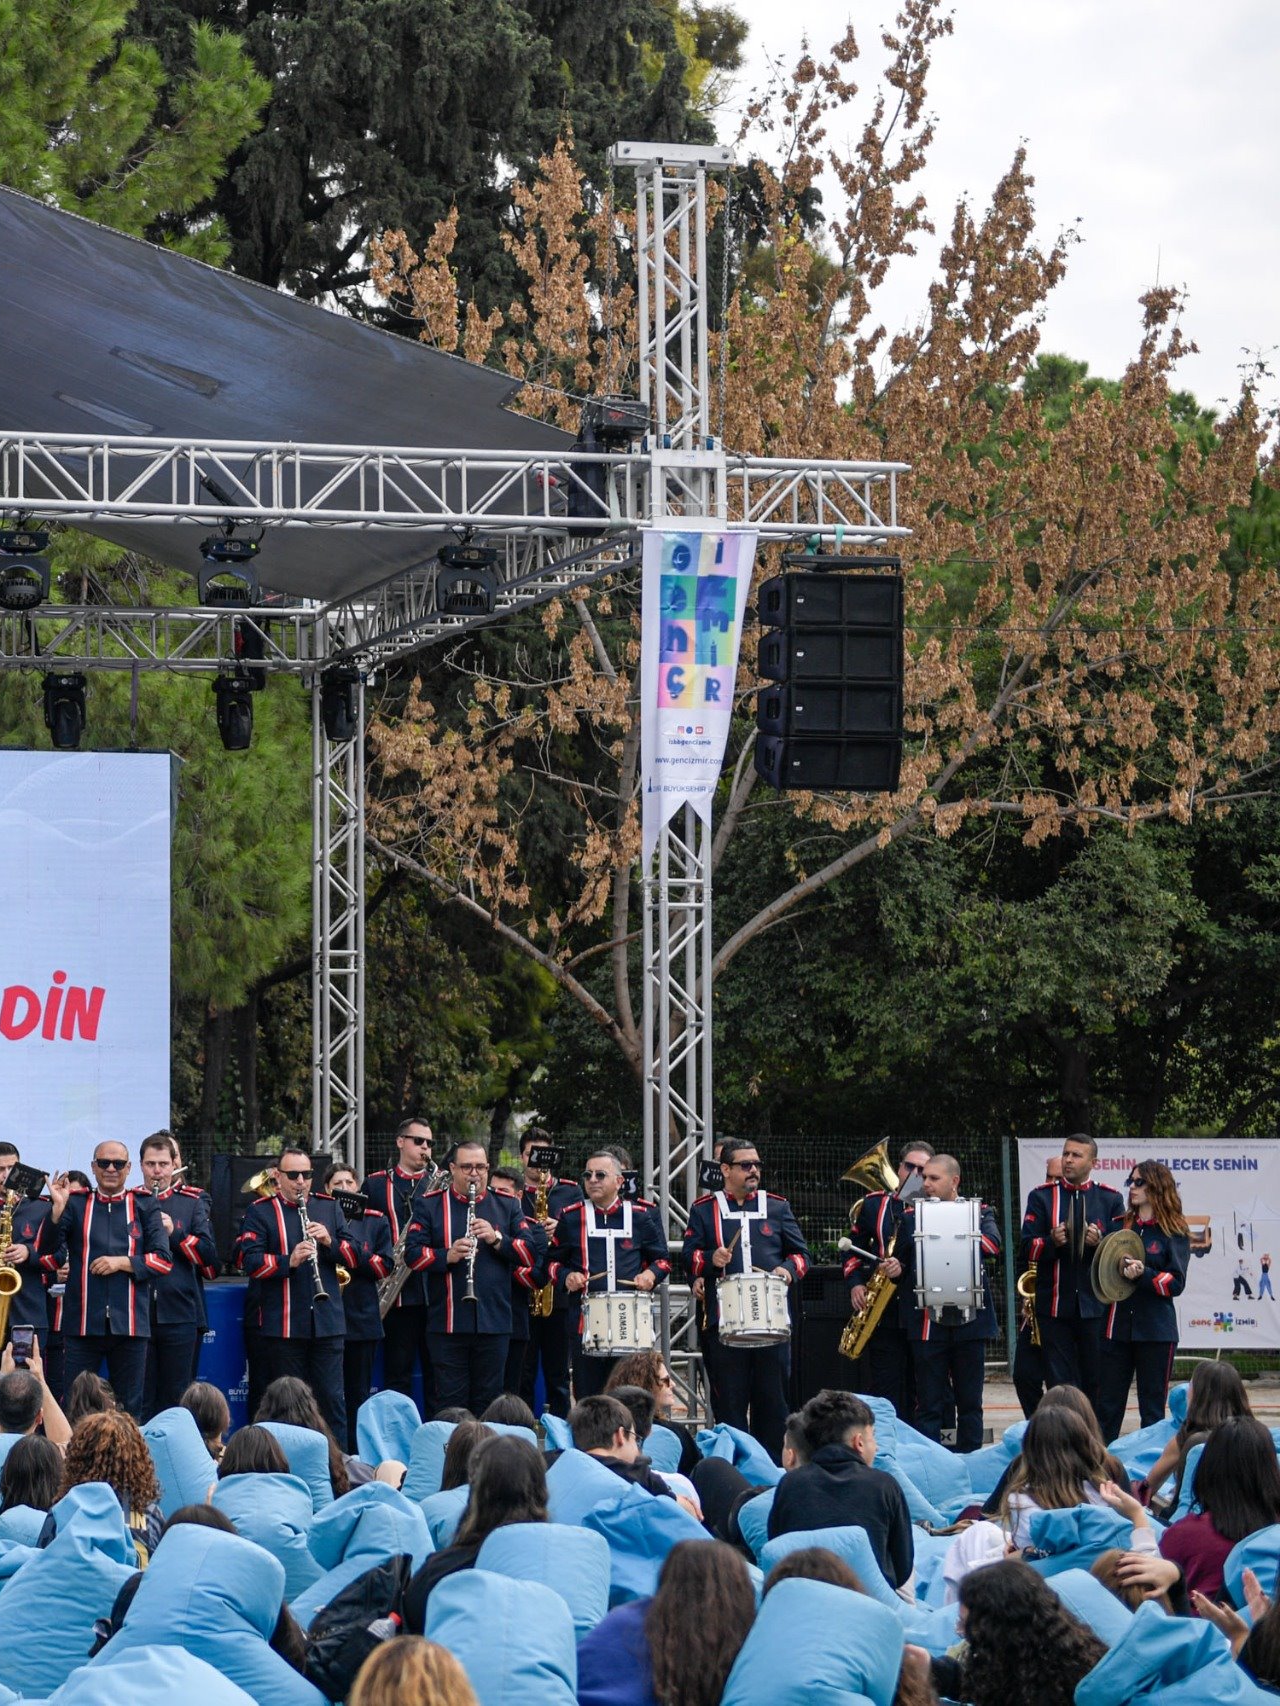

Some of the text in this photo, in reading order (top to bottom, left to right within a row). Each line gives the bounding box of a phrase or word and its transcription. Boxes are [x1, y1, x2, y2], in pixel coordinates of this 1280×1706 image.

[1213, 1155, 1257, 1170] SENİN
[750, 1293, 760, 1321] YAMAHA
[620, 1311, 628, 1341] YAMAHA
